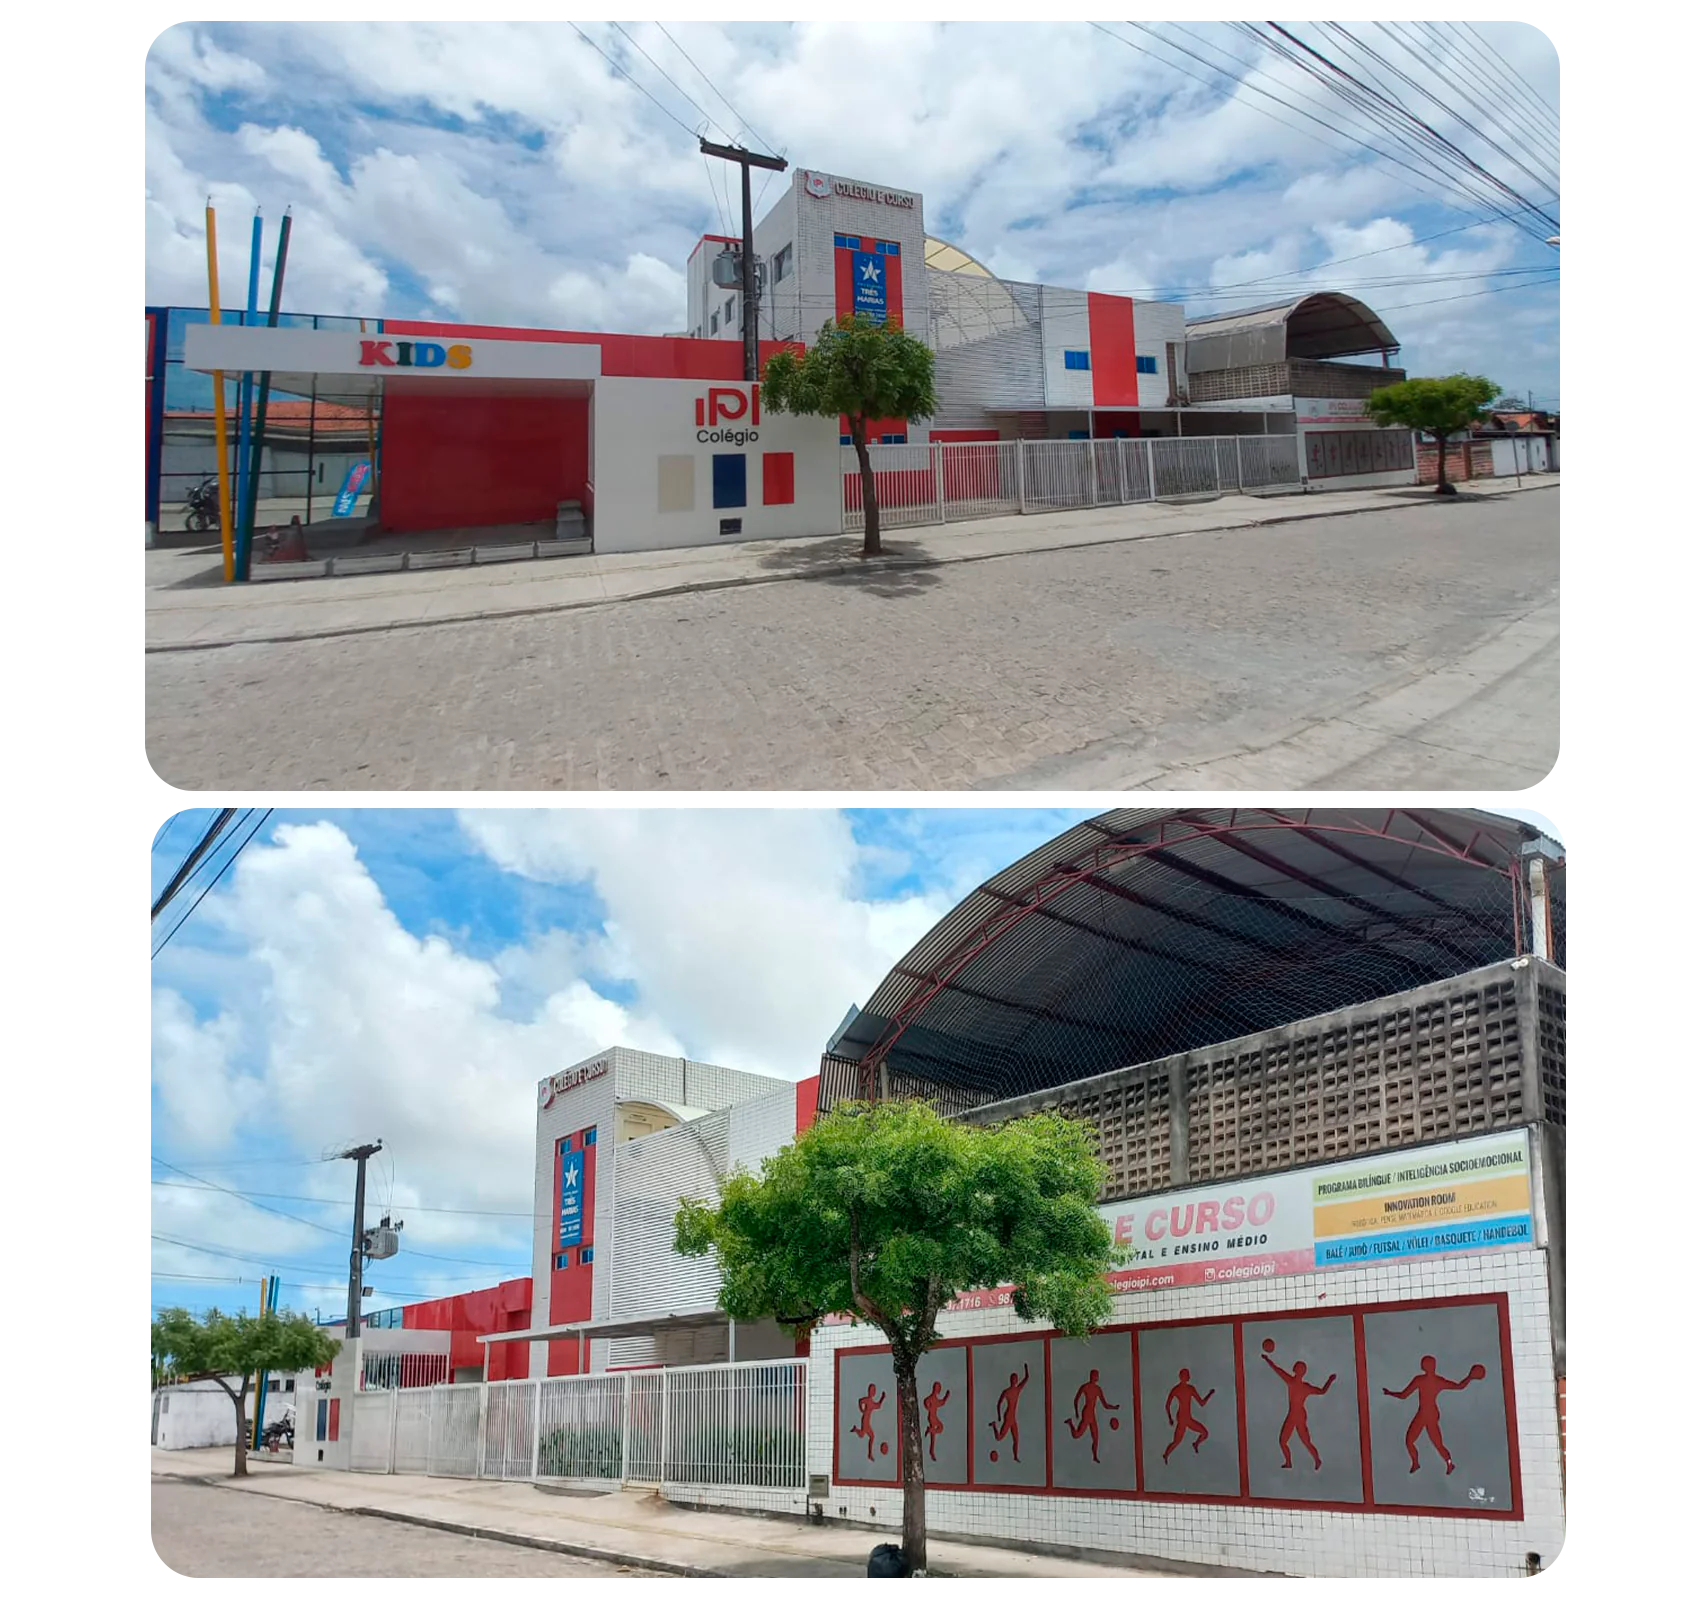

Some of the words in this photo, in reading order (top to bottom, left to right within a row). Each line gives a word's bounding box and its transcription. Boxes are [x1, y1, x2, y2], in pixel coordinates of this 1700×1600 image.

[358, 340, 472, 369] KIDS
[696, 428, 759, 447] Colégio
[1318, 1180, 1358, 1196] PROGRAMA
[1357, 1172, 1391, 1189] BILÍNGUE
[1397, 1161, 1448, 1183] INTELIGÊNCIA
[1449, 1151, 1523, 1173] SOCIOEMOCIONAL
[1384, 1196, 1431, 1213] INNOVATION
[1431, 1192, 1456, 1206] ROOM
[1114, 1214, 1135, 1244] E
[1144, 1191, 1276, 1241] CURSO
[1161, 1247, 1168, 1257] E
[1174, 1240, 1219, 1256] ENSINO
[1226, 1234, 1268, 1249] MÉDIO
[1326, 1244, 1343, 1260] BALÉ
[1373, 1240, 1401, 1254] FUTSAL
[1434, 1229, 1477, 1246] BASQUETE
[1483, 1223, 1529, 1241] HANDEBOL
[1218, 1261, 1276, 1280] colegioipi
